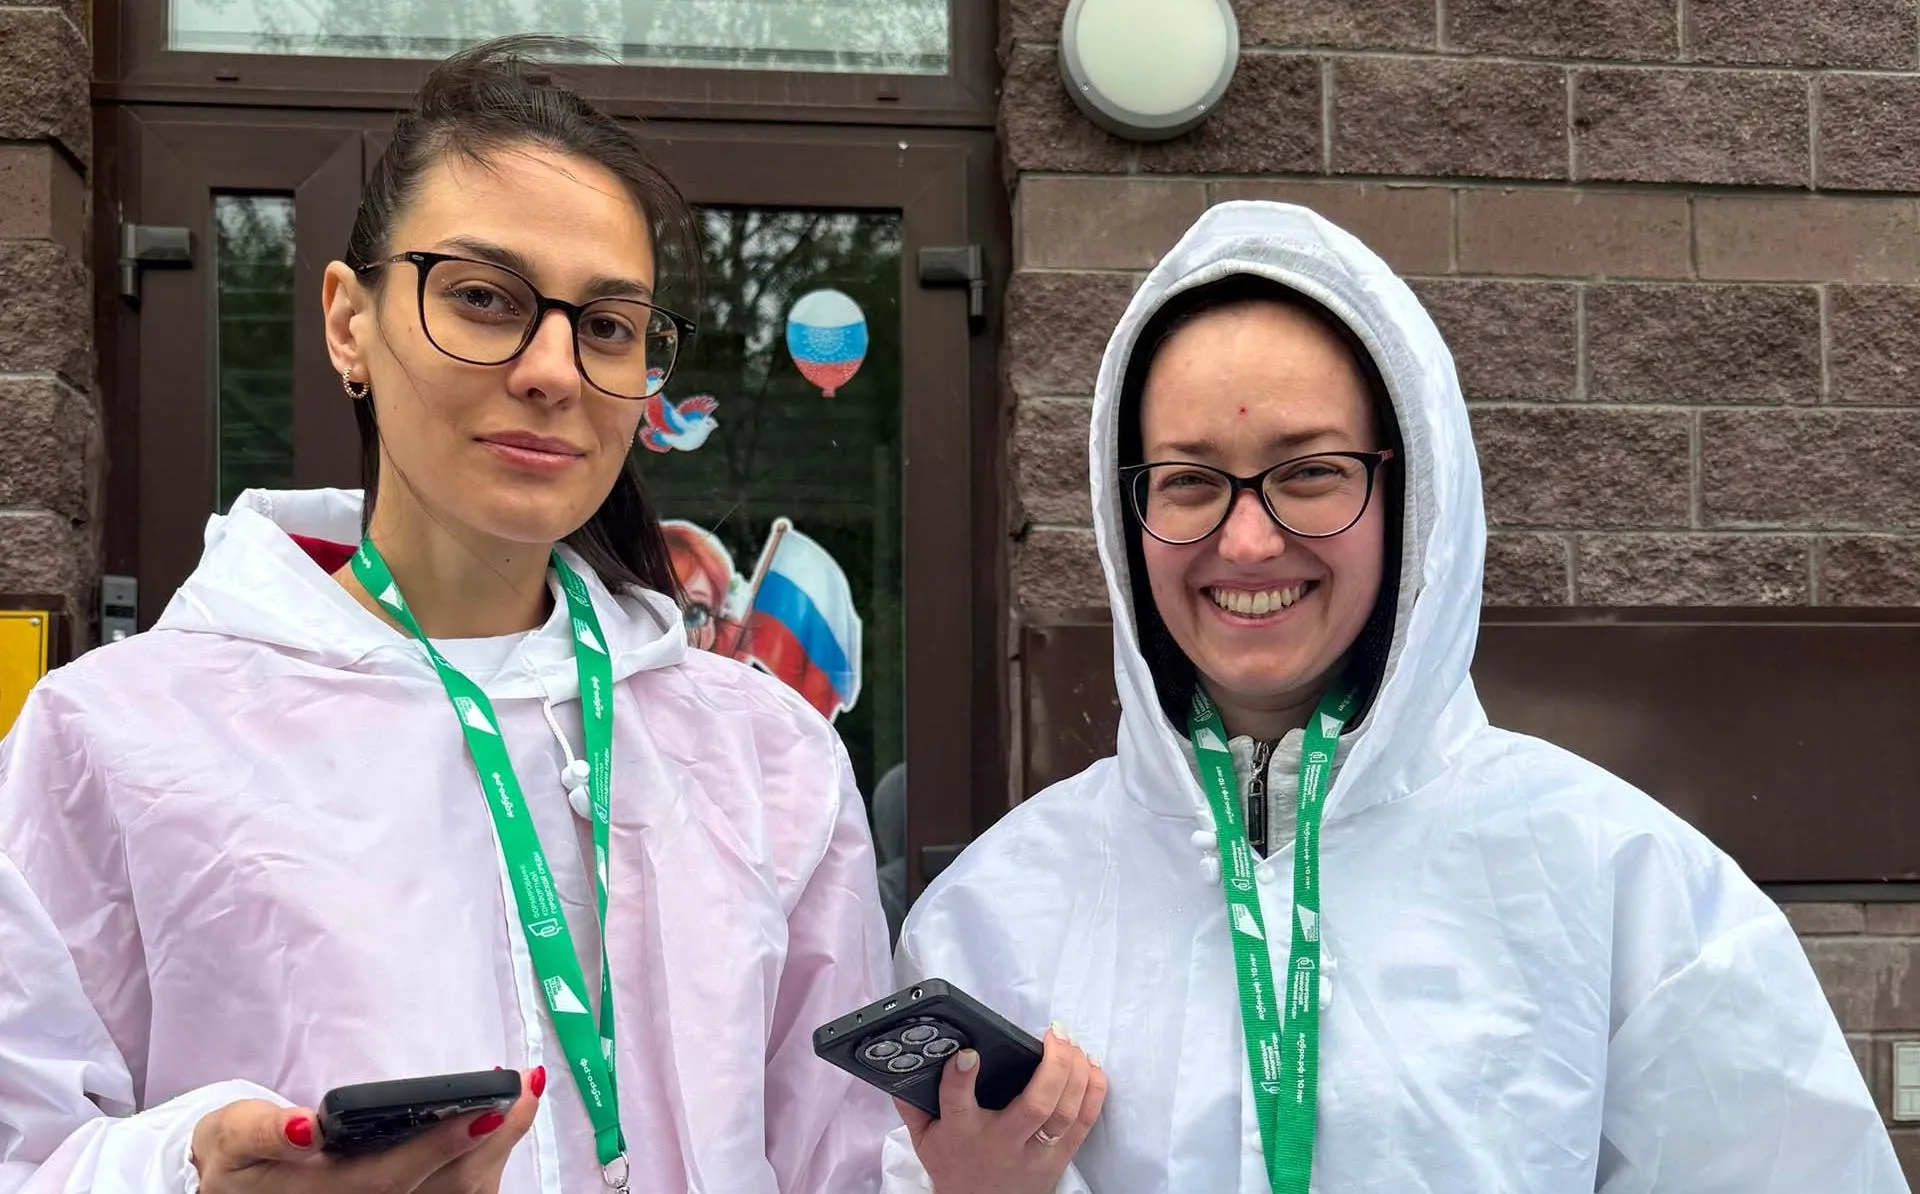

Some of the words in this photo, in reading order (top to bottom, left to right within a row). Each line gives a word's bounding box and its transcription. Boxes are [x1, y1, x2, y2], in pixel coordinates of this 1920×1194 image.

[1250, 966, 1258, 977] 10
[578, 1058, 602, 1107] добро.рф
[1296, 1078, 1304, 1088] 10
